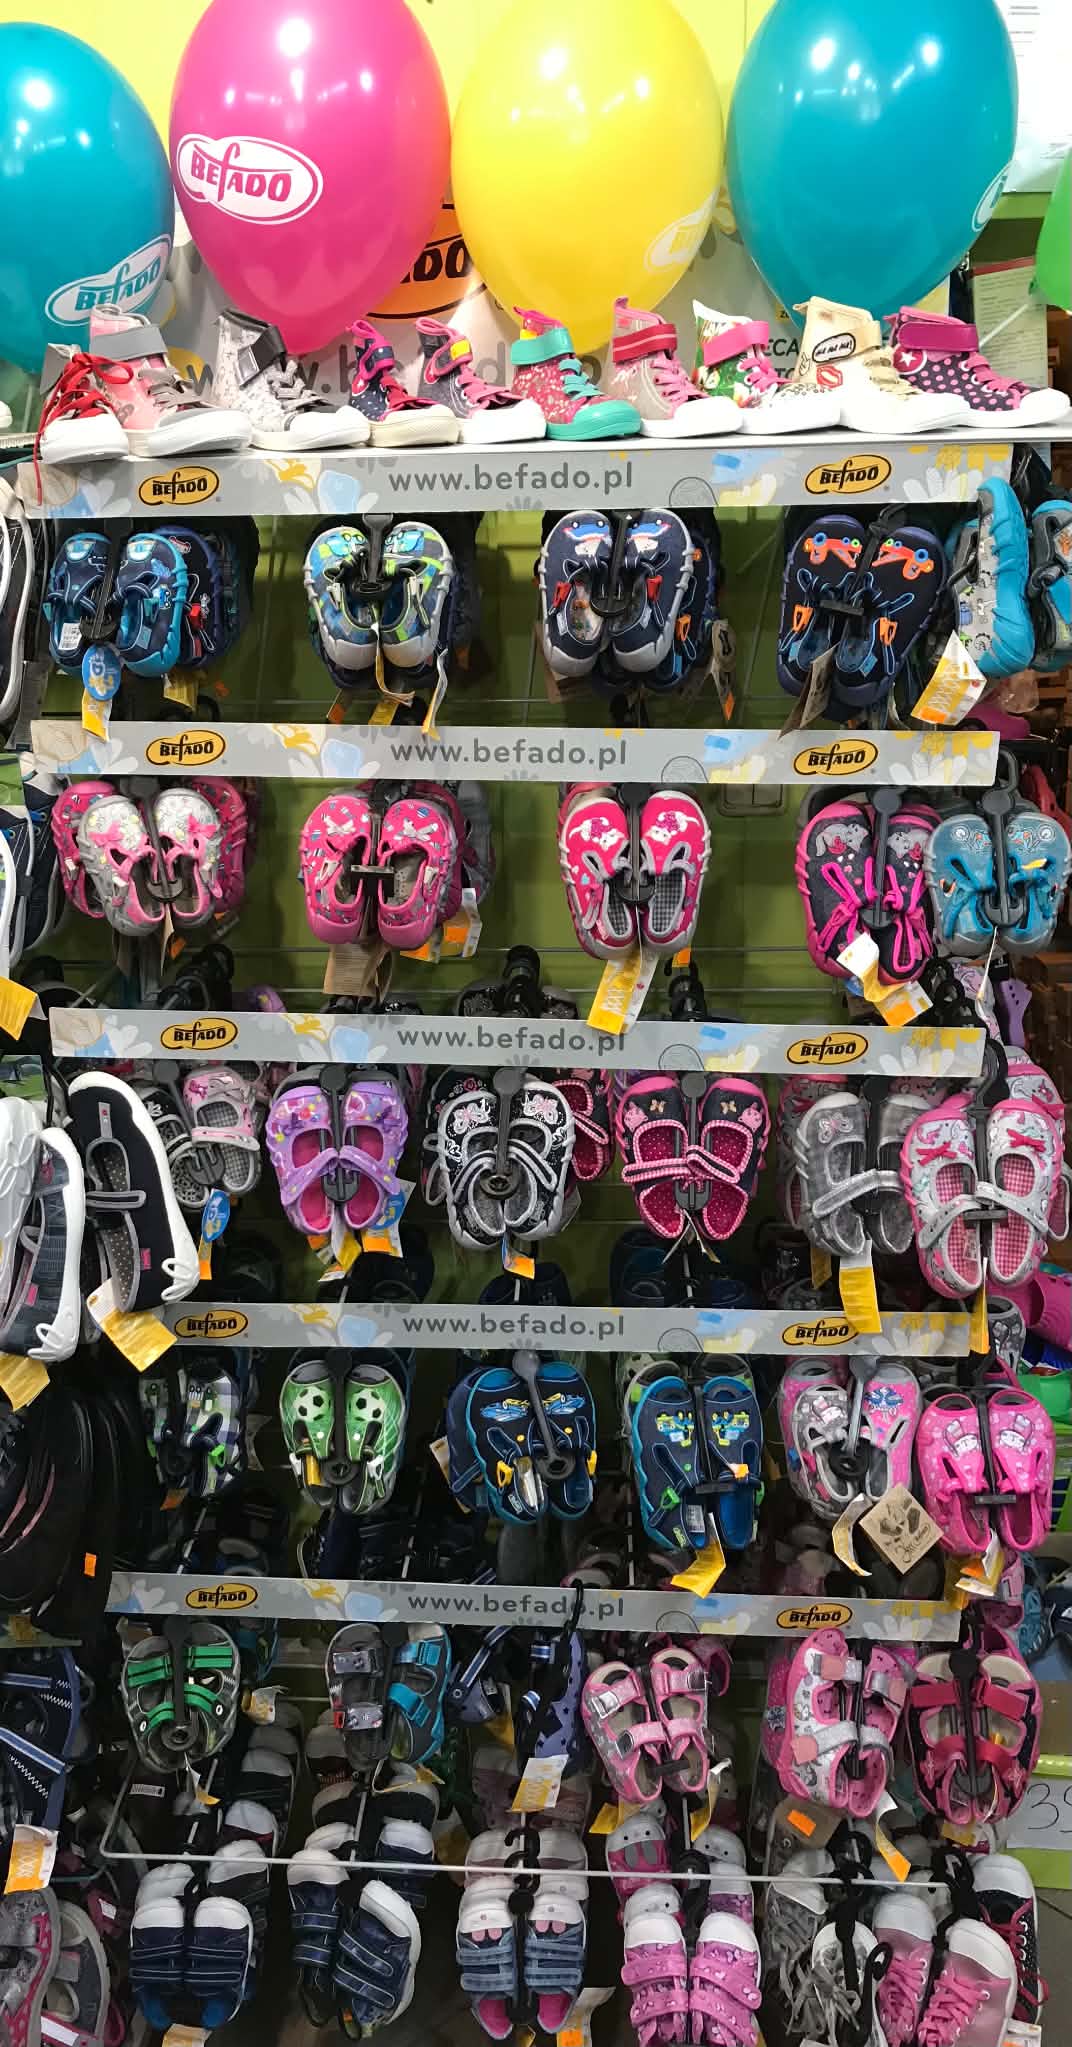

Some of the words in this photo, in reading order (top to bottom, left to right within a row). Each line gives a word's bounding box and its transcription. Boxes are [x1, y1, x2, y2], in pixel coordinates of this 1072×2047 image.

[388, 461, 633, 495] www.befado.pl
[390, 738, 627, 770] www.befado.pl
[397, 1025, 625, 1056] www.befado.pl
[402, 1312, 625, 1340] www.befado.pl
